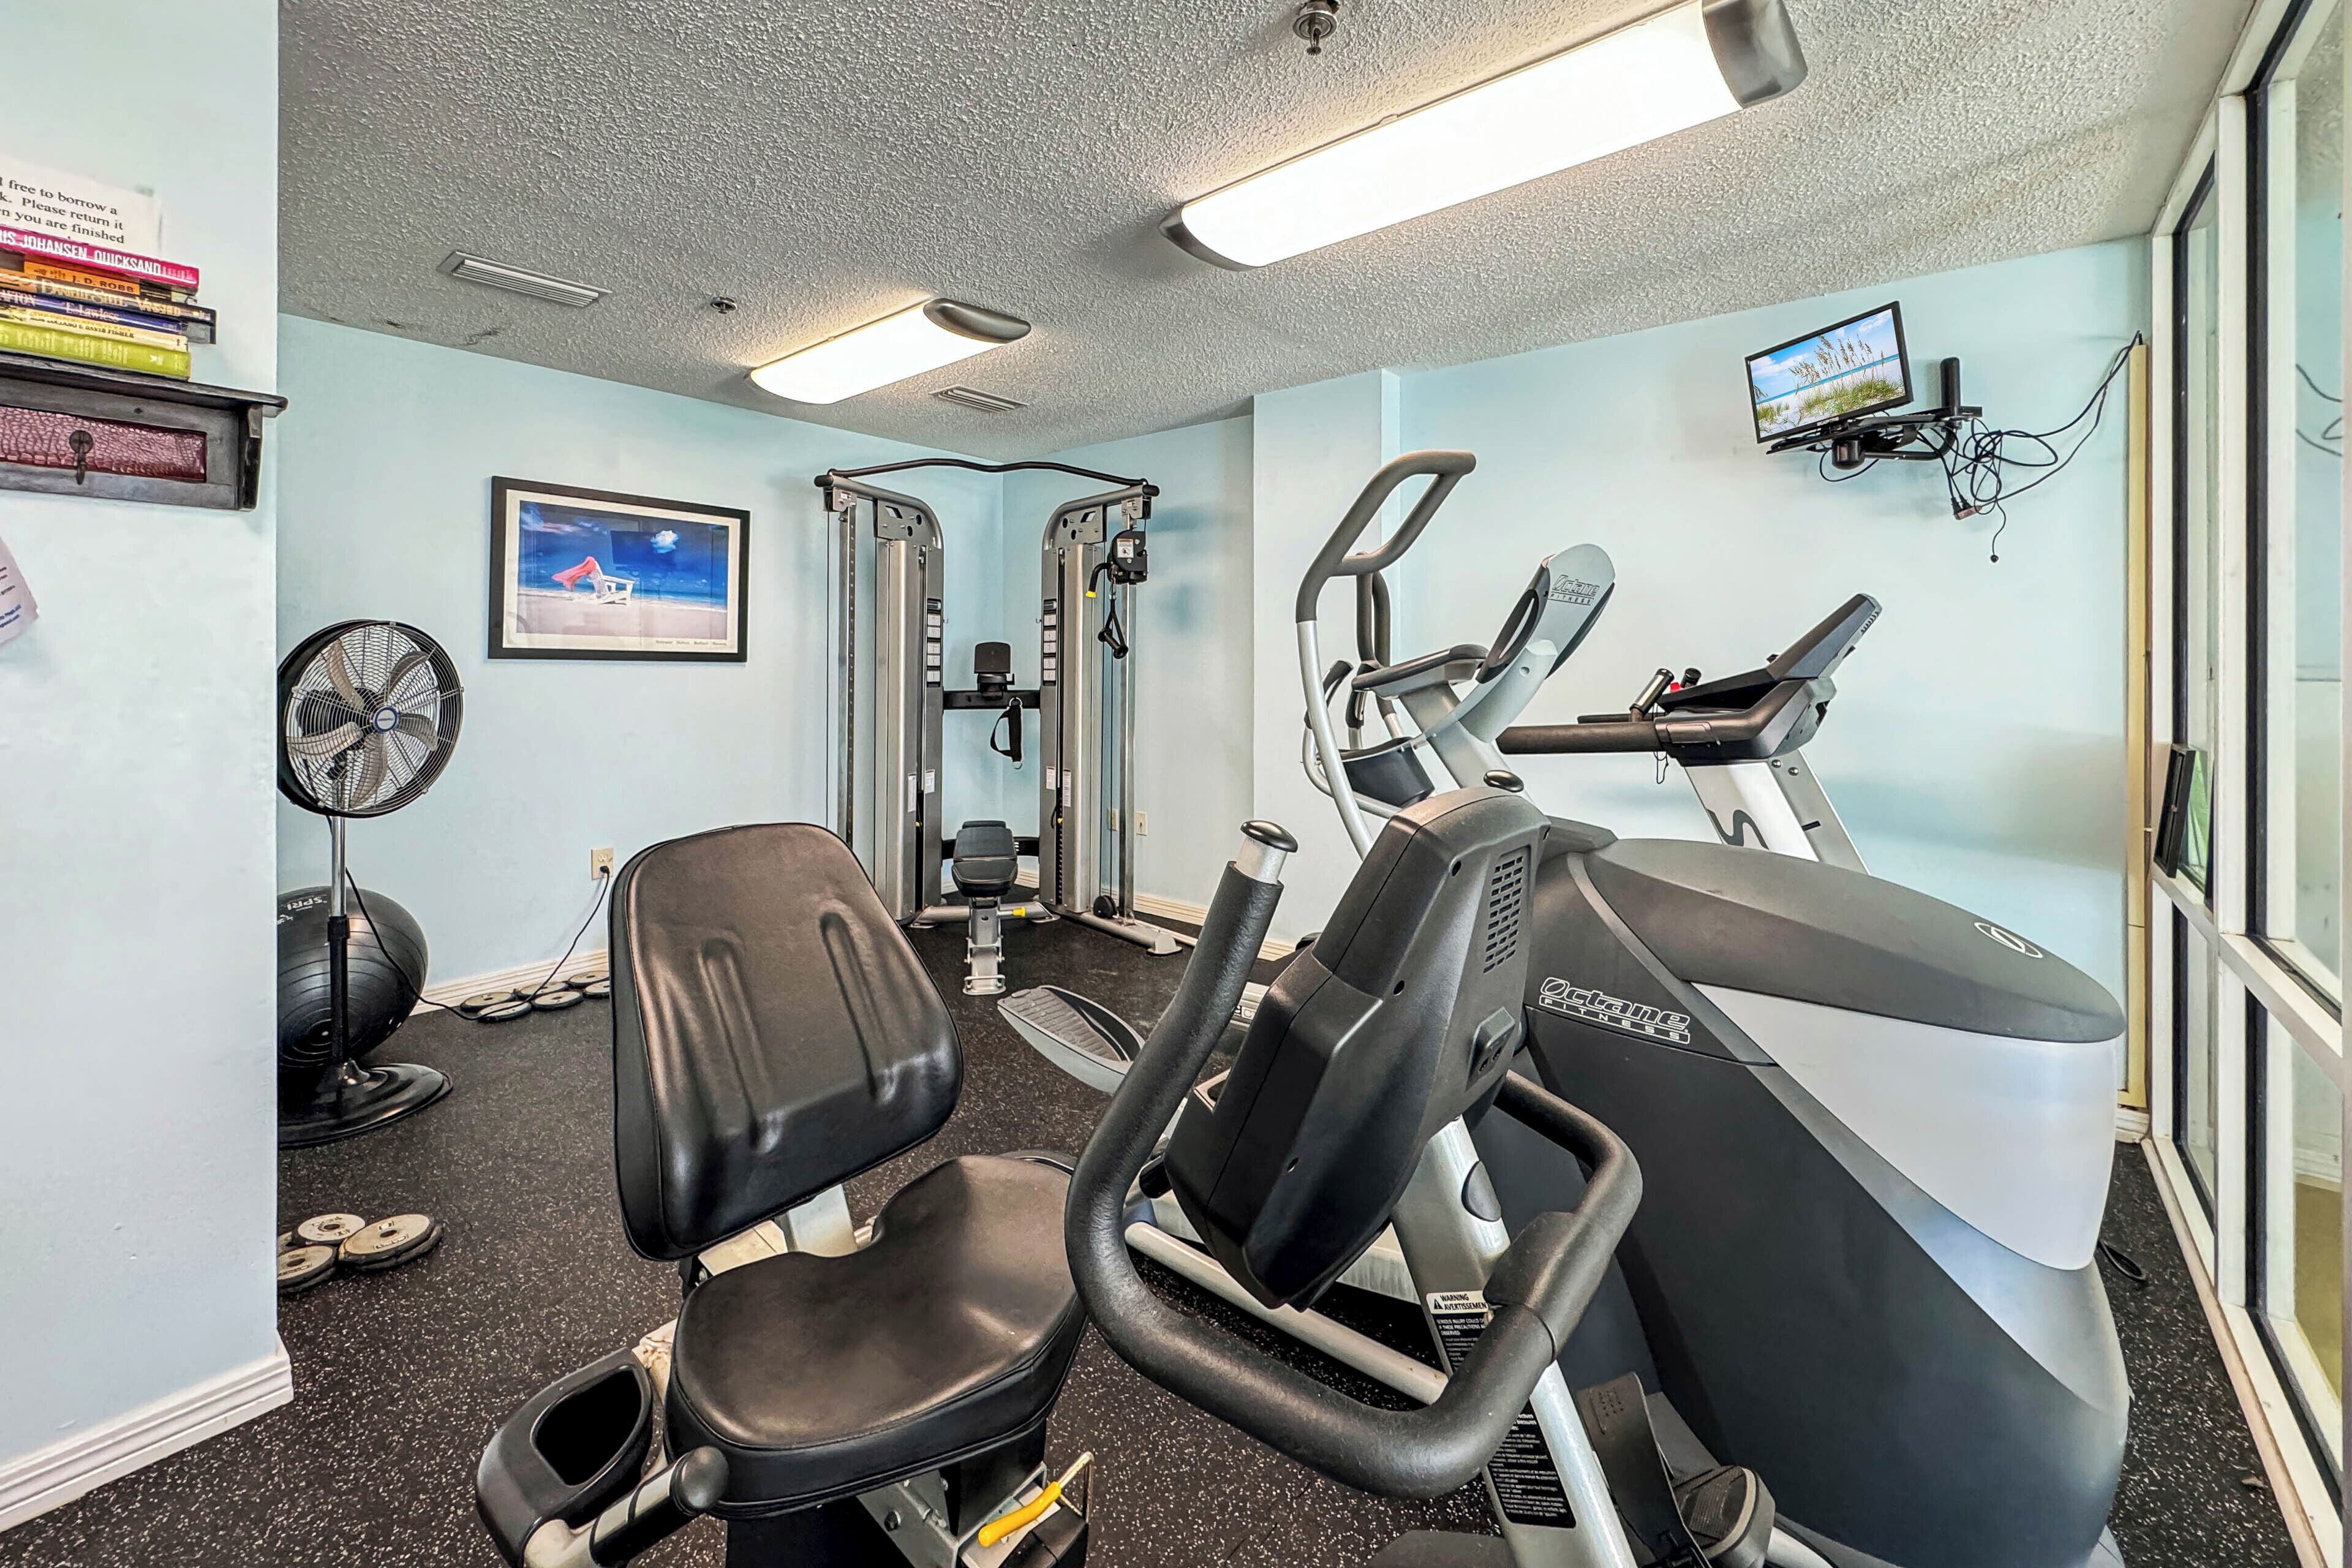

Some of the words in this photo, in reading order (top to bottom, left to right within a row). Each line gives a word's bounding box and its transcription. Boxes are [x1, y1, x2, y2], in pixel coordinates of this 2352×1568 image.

[9, 179, 36, 194] free
[40, 189, 53, 198] to
[58, 192, 107, 211] borrow
[15, 212, 41, 224] you
[46, 219, 67, 230] are
[72, 224, 124, 244] finished
[22, 197, 66, 216] Please
[70, 211, 110, 227] return
[115, 220, 123, 230] it
[20, 235, 87, 258] JOHANSEN
[94, 250, 162, 276] QUICKSAND
[100, 281, 134, 292] ROBB
[1550, 594, 1591, 604] FITNESS
[1552, 575, 1600, 597] Octane
[1540, 977, 1690, 1030] Octane
[1543, 998, 1681, 1041] FITNESS
